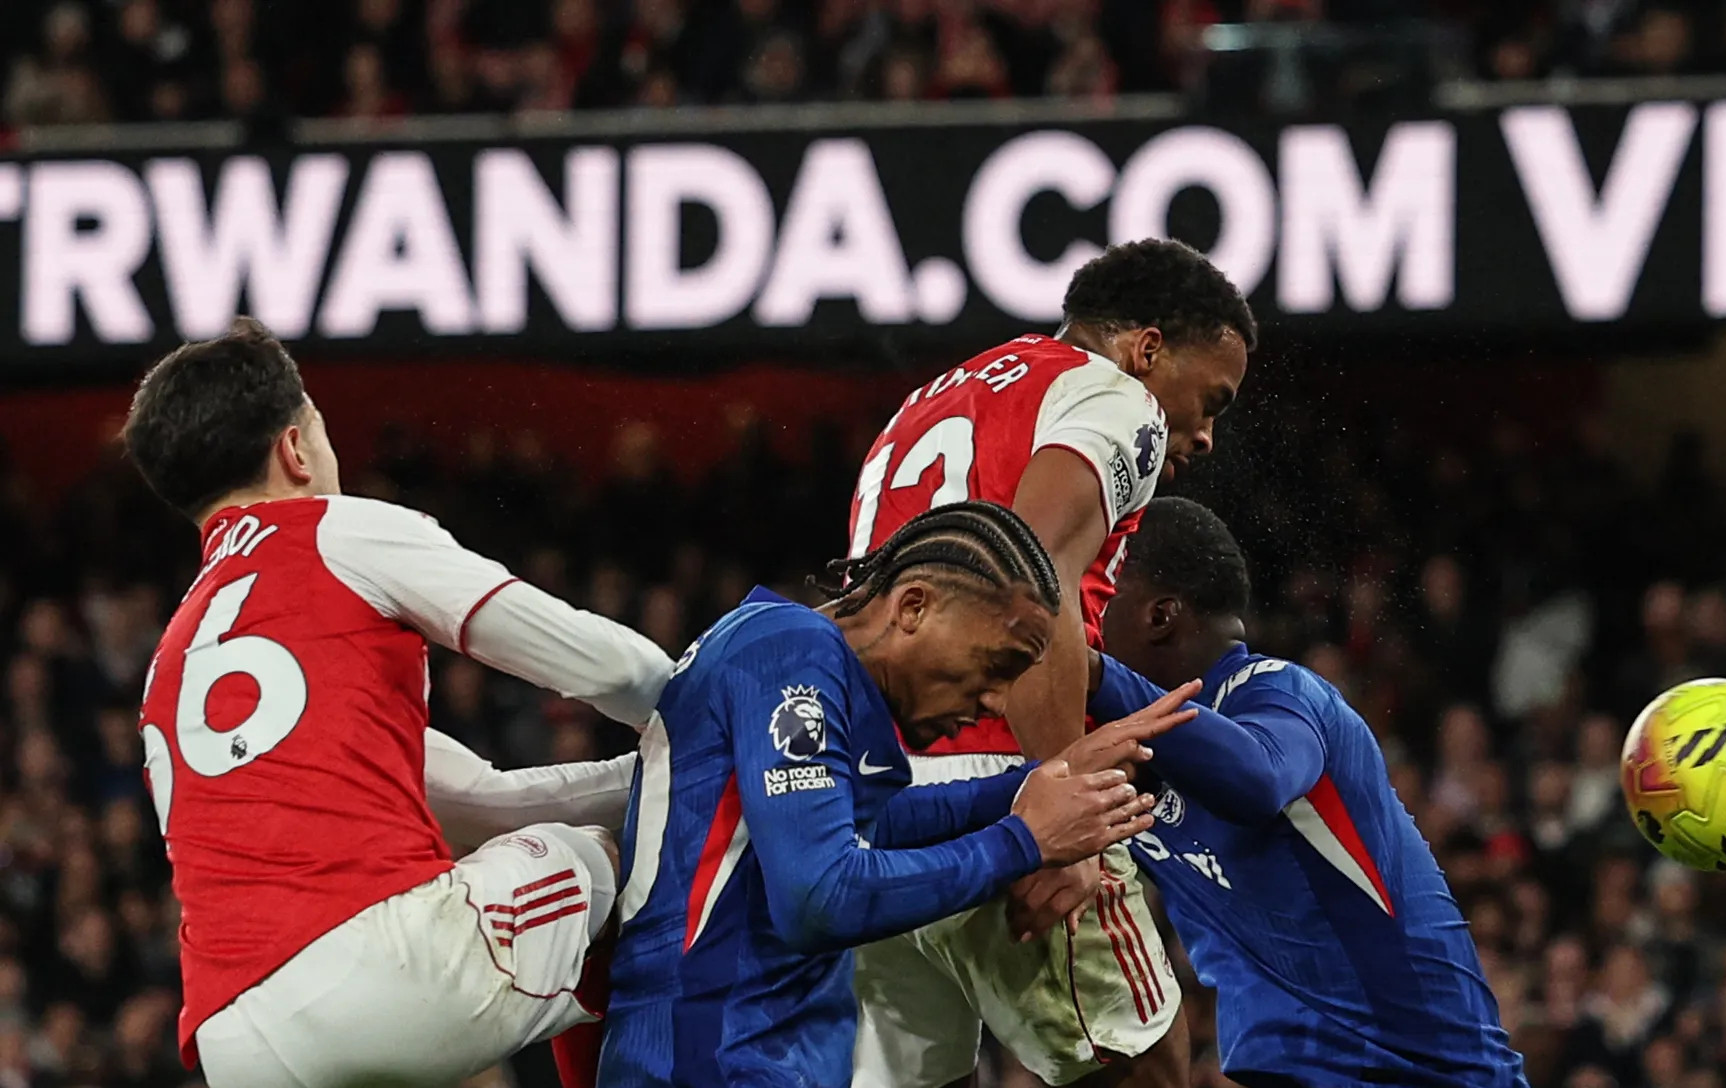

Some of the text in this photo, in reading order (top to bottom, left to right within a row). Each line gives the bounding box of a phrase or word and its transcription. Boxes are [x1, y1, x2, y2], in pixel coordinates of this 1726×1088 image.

[0, 126, 1458, 345] RWANDA.COM
[764, 765, 827, 783] No room
[765, 776, 836, 797] for racism
